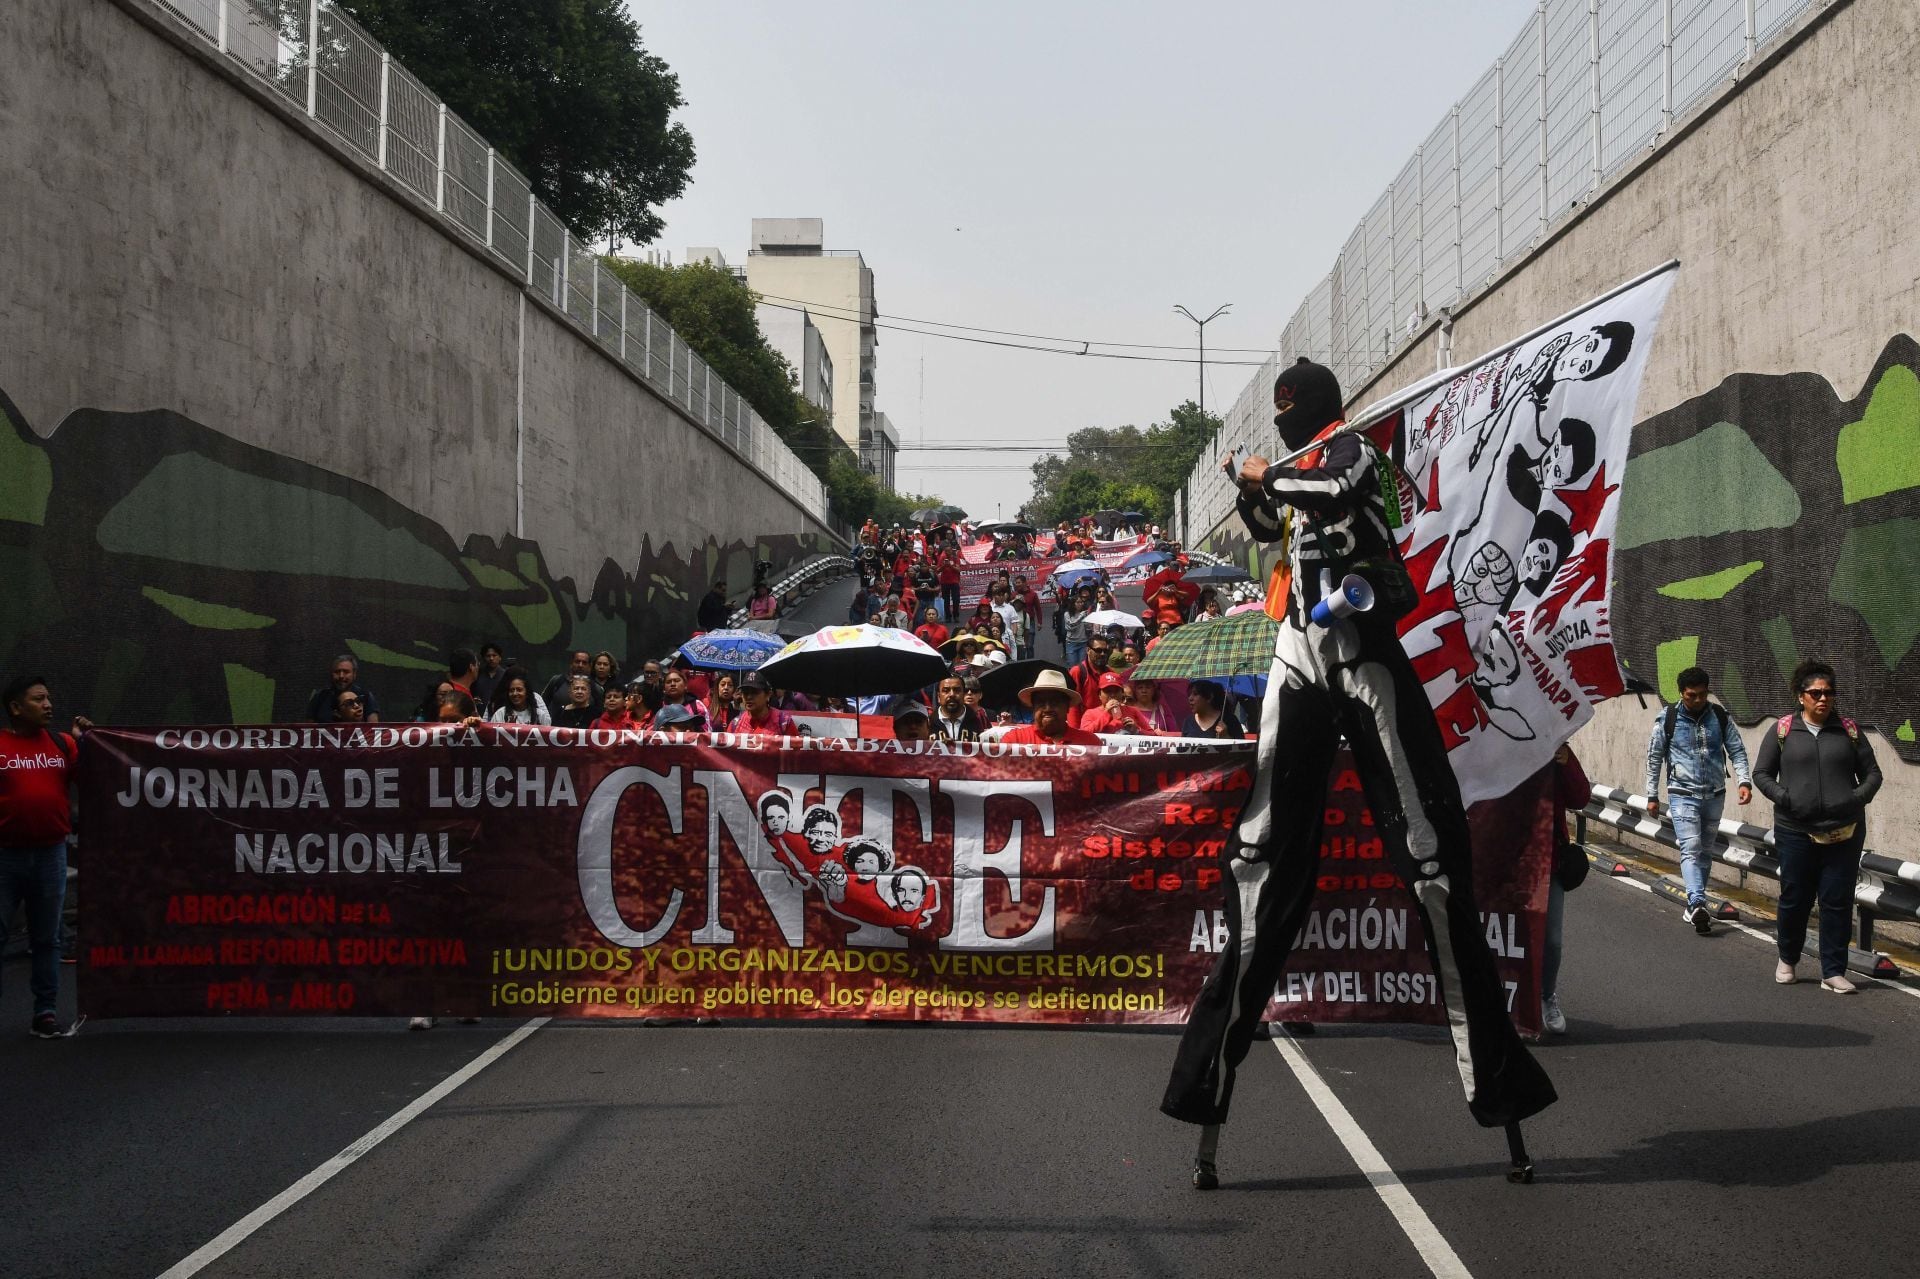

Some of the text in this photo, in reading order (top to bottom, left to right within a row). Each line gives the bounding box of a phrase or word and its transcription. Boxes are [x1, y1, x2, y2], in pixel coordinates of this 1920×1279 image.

[1545, 619, 1592, 659] JUSTCIA
[1507, 610, 1580, 721] AYOTZINAPA
[155, 727, 483, 750] COORDINADORA
[493, 728, 698, 748] NACIONAL
[707, 731, 765, 750] DE
[777, 735, 1087, 758] TRABAJADORES
[0, 753, 66, 770] Calvin Klein
[117, 766, 578, 809] JORNADA DE LUCHA
[235, 833, 462, 873] NACIONAL
[577, 766, 1056, 951] CNTE
[1082, 835, 1228, 859] Sistem
[1130, 869, 1183, 891] de
[166, 889, 391, 924] ABROGACIÓN DE LA
[1189, 898, 1408, 953] ABACIÓN
[90, 938, 468, 968] MAL LLAMADA REFORMA EDUCATIVA
[492, 948, 1165, 978] ¡UNIDOS Y ORGANIZADOS, VENCEREMOS!
[207, 976, 270, 1009] PEÑA
[289, 982, 355, 1009] AMLO
[492, 981, 1165, 1012] ¡Gobierne quien gobierne, los derechos se defienden!
[1274, 972, 1437, 1005] LEY DEL ISSST
